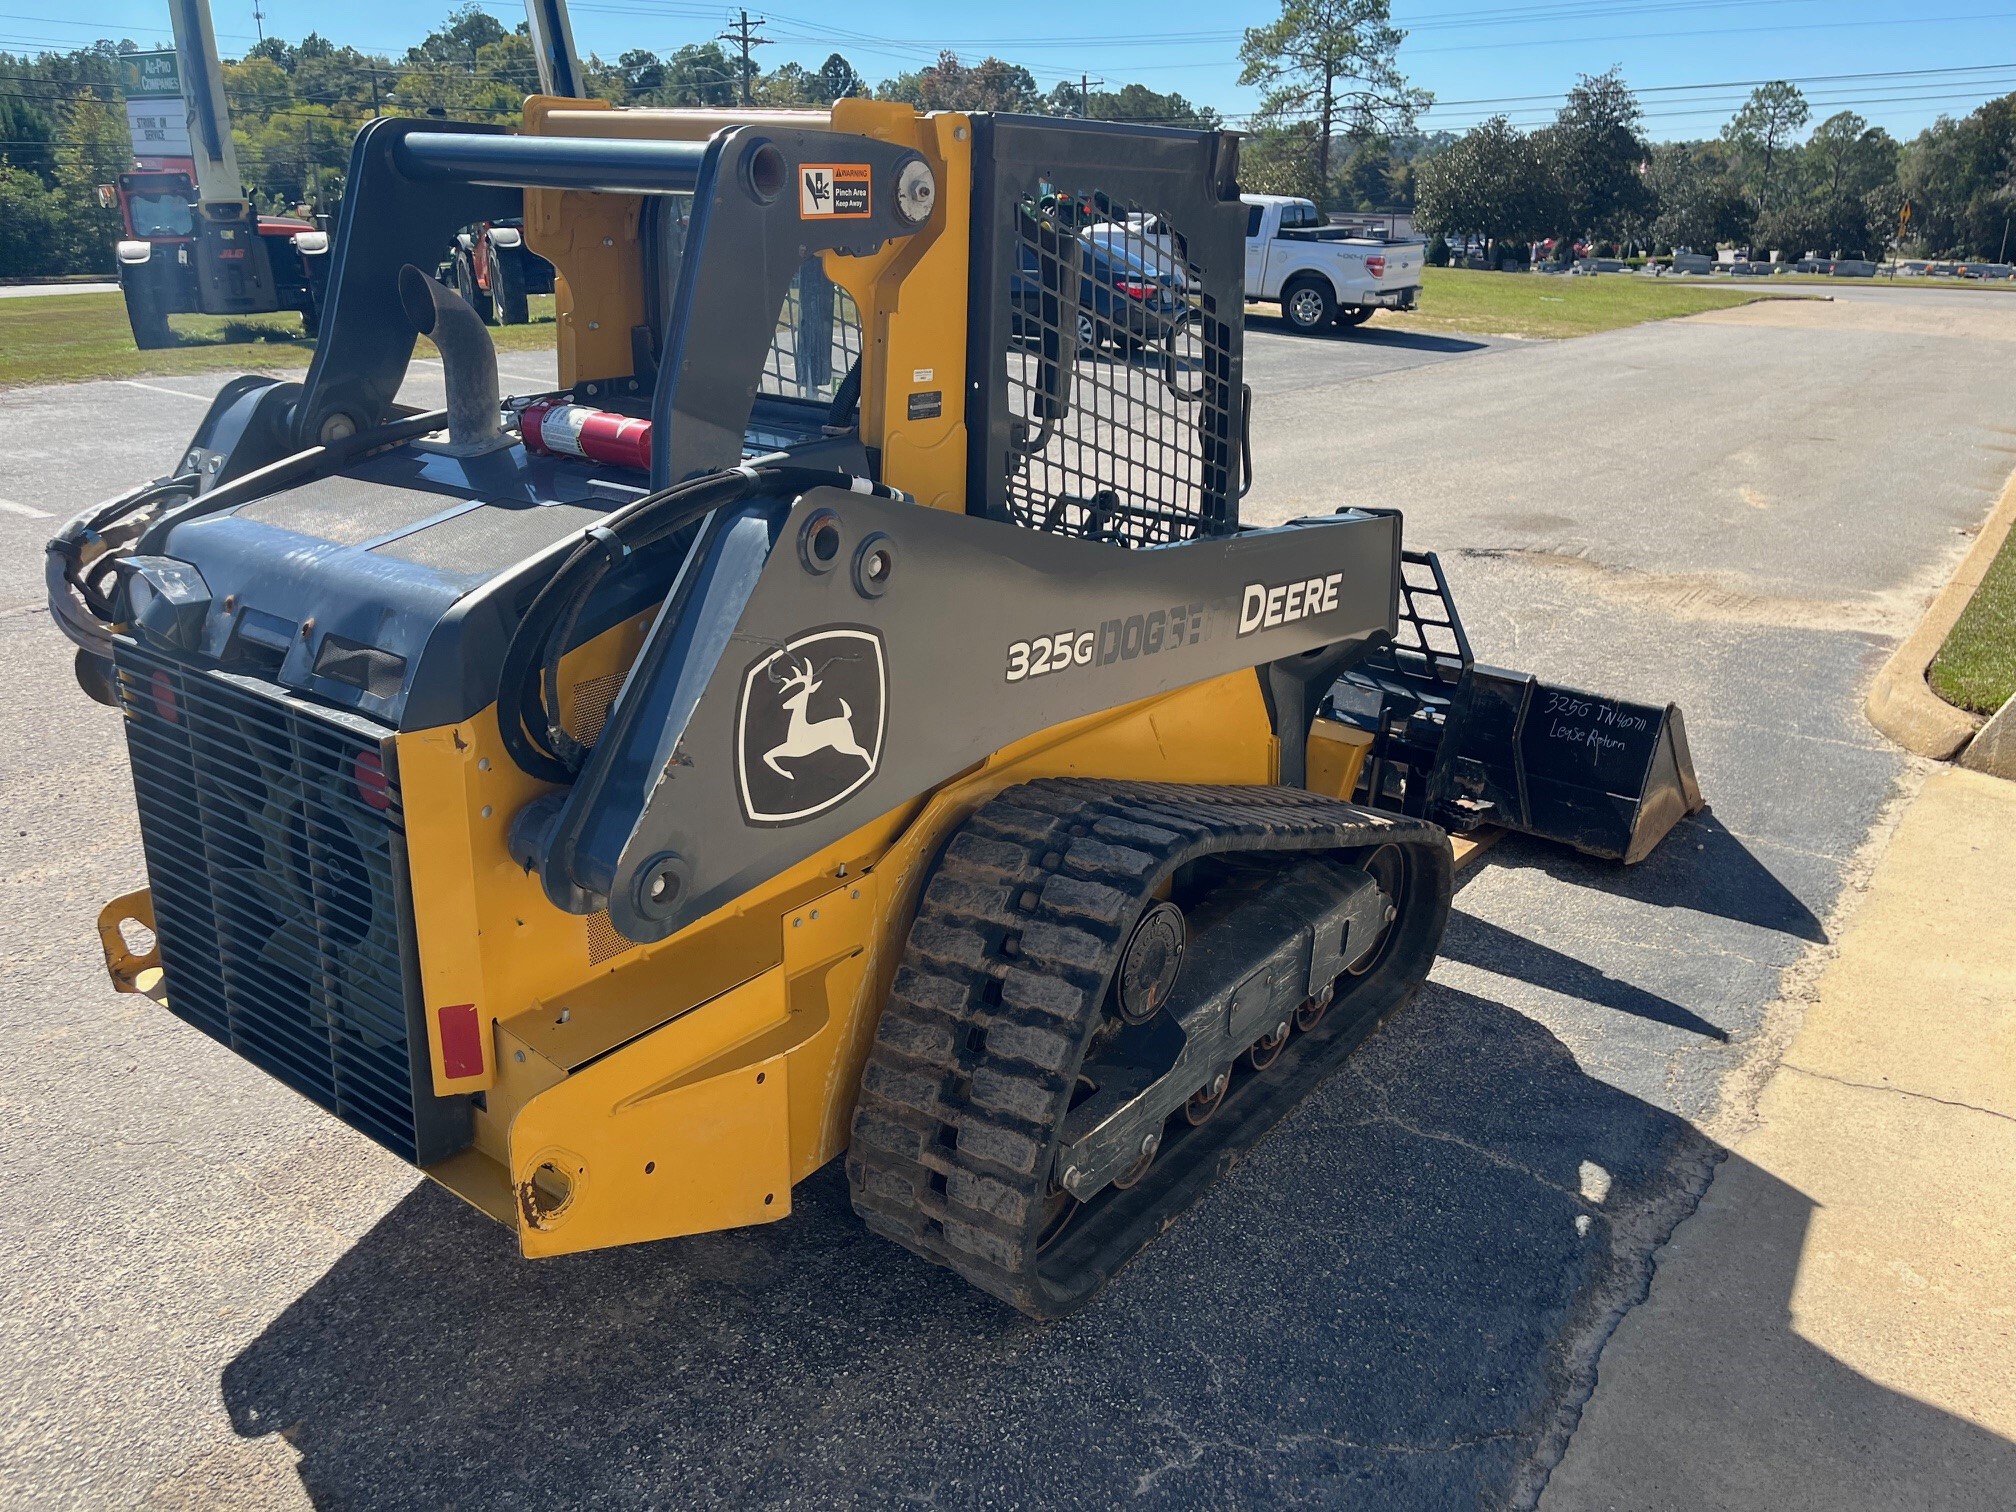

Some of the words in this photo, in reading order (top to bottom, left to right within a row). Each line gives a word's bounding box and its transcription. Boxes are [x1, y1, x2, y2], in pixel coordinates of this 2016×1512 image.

[144, 129, 166, 141] SERVICE
[841, 169, 868, 177] WARNING
[835, 188, 852, 197] Pinch
[853, 188, 867, 197] Area
[835, 199, 849, 208] Keep
[849, 199, 863, 208] Away
[1238, 572, 1343, 635] DEERE
[1005, 630, 1096, 683] 325G
[1544, 692, 1593, 717] 325G
[1549, 718, 1586, 742] Lease
[1586, 728, 1626, 751] Return
